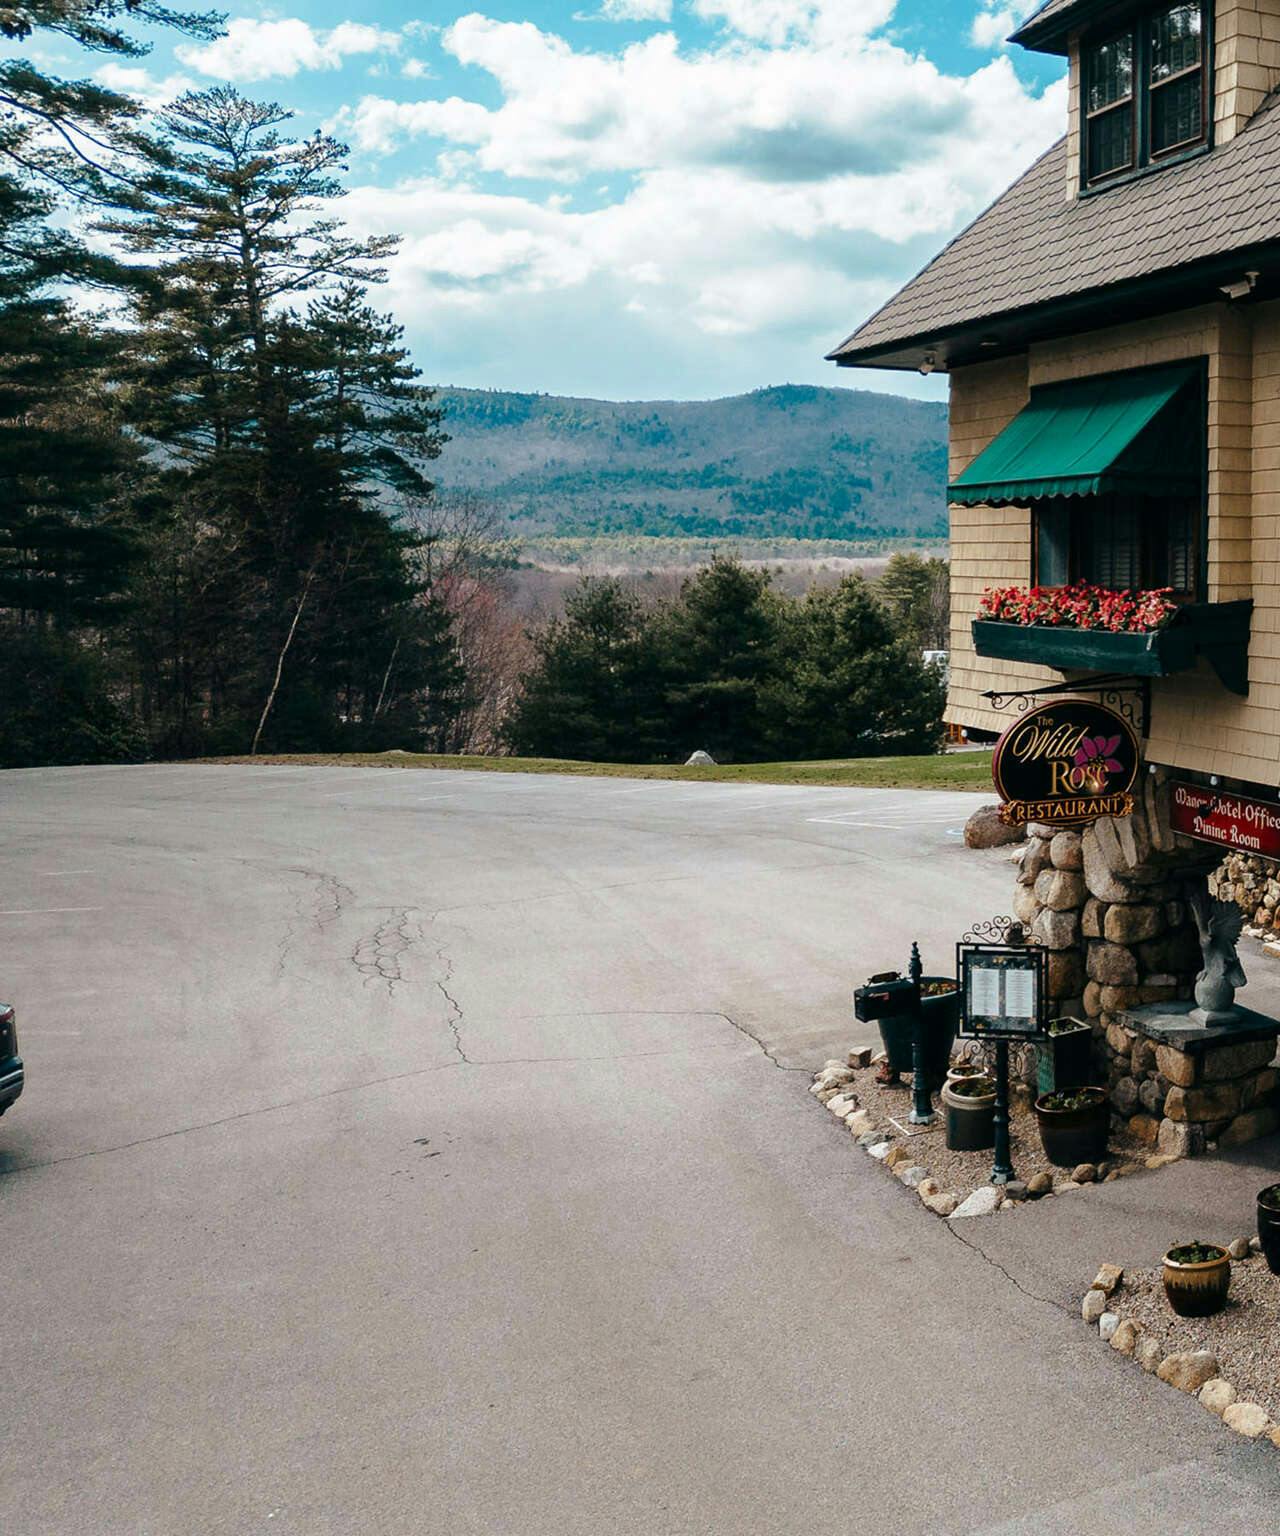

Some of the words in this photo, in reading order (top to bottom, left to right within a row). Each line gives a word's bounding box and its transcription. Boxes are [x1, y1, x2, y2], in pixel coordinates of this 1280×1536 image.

[1036, 716, 1054, 726] The
[1012, 723, 1090, 763] Wild
[1047, 760, 1110, 795] Rose
[1016, 797, 1121, 820] RESTAURANT
[1193, 815, 1228, 840] Dining
[1230, 824, 1261, 849] Room
